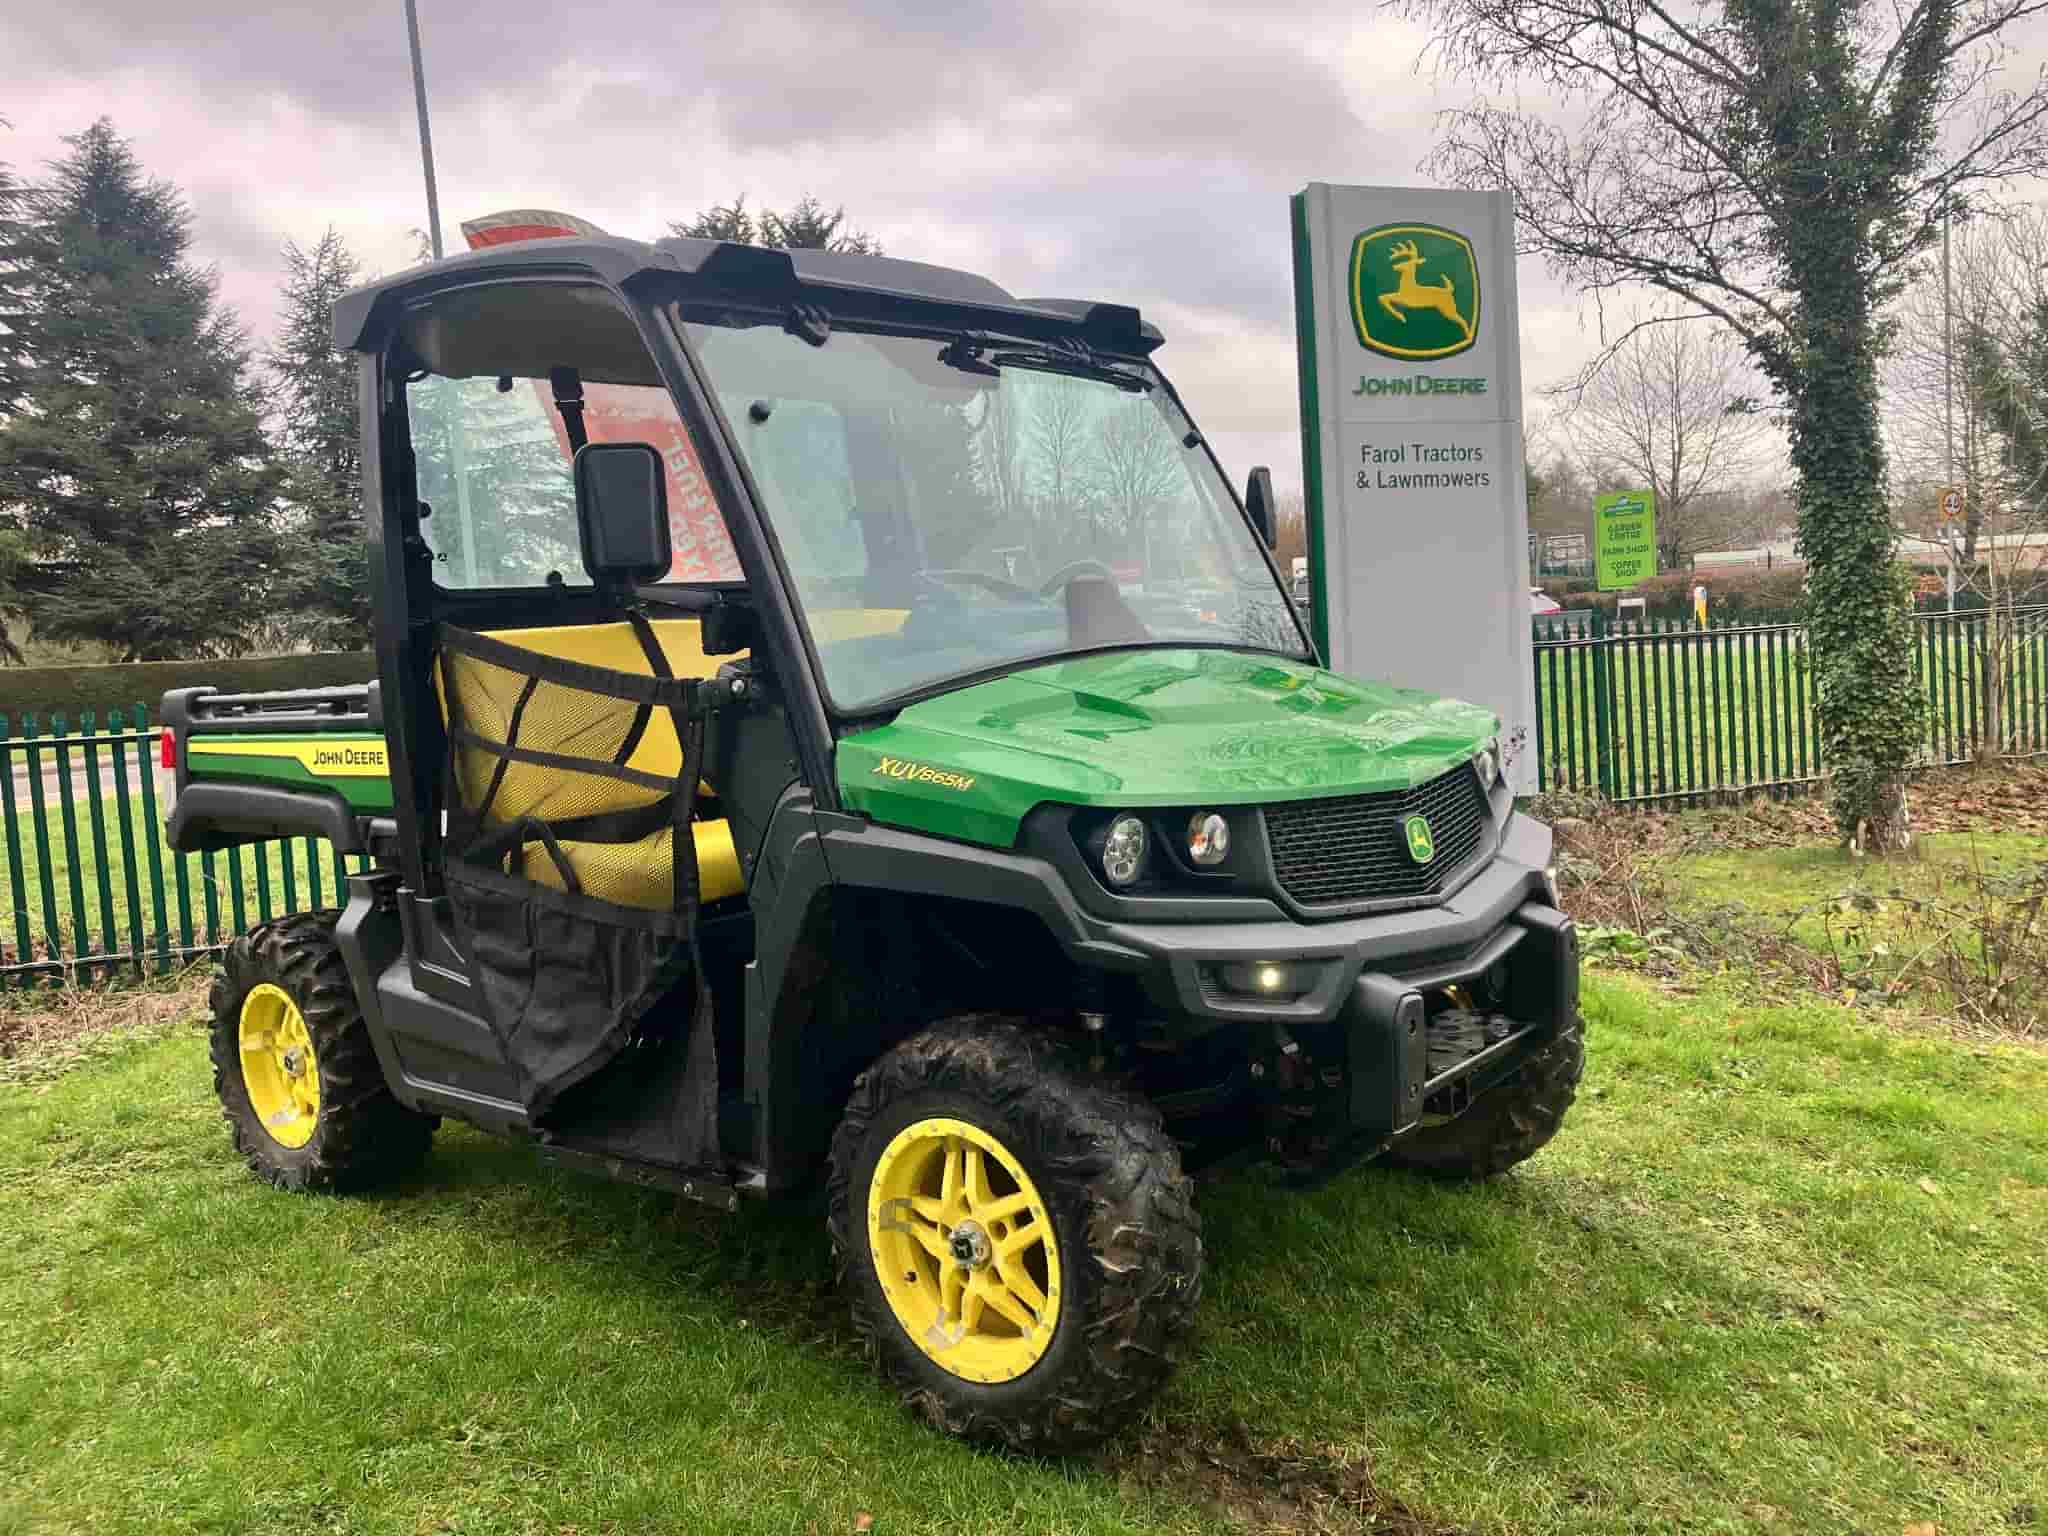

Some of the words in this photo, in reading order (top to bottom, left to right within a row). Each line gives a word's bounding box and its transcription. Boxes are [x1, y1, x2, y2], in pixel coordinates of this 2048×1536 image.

[1352, 375, 1412, 395] JOHN
[1415, 375, 1488, 395] DEERE
[1361, 443, 1405, 463] Farol
[1410, 442, 1483, 463] Tractors
[1356, 470, 1370, 489] &
[1377, 469, 1490, 488] Lawnmowers
[313, 748, 343, 766] JOHN
[345, 748, 384, 766] DEERE
[872, 757, 975, 791] XUV865M
